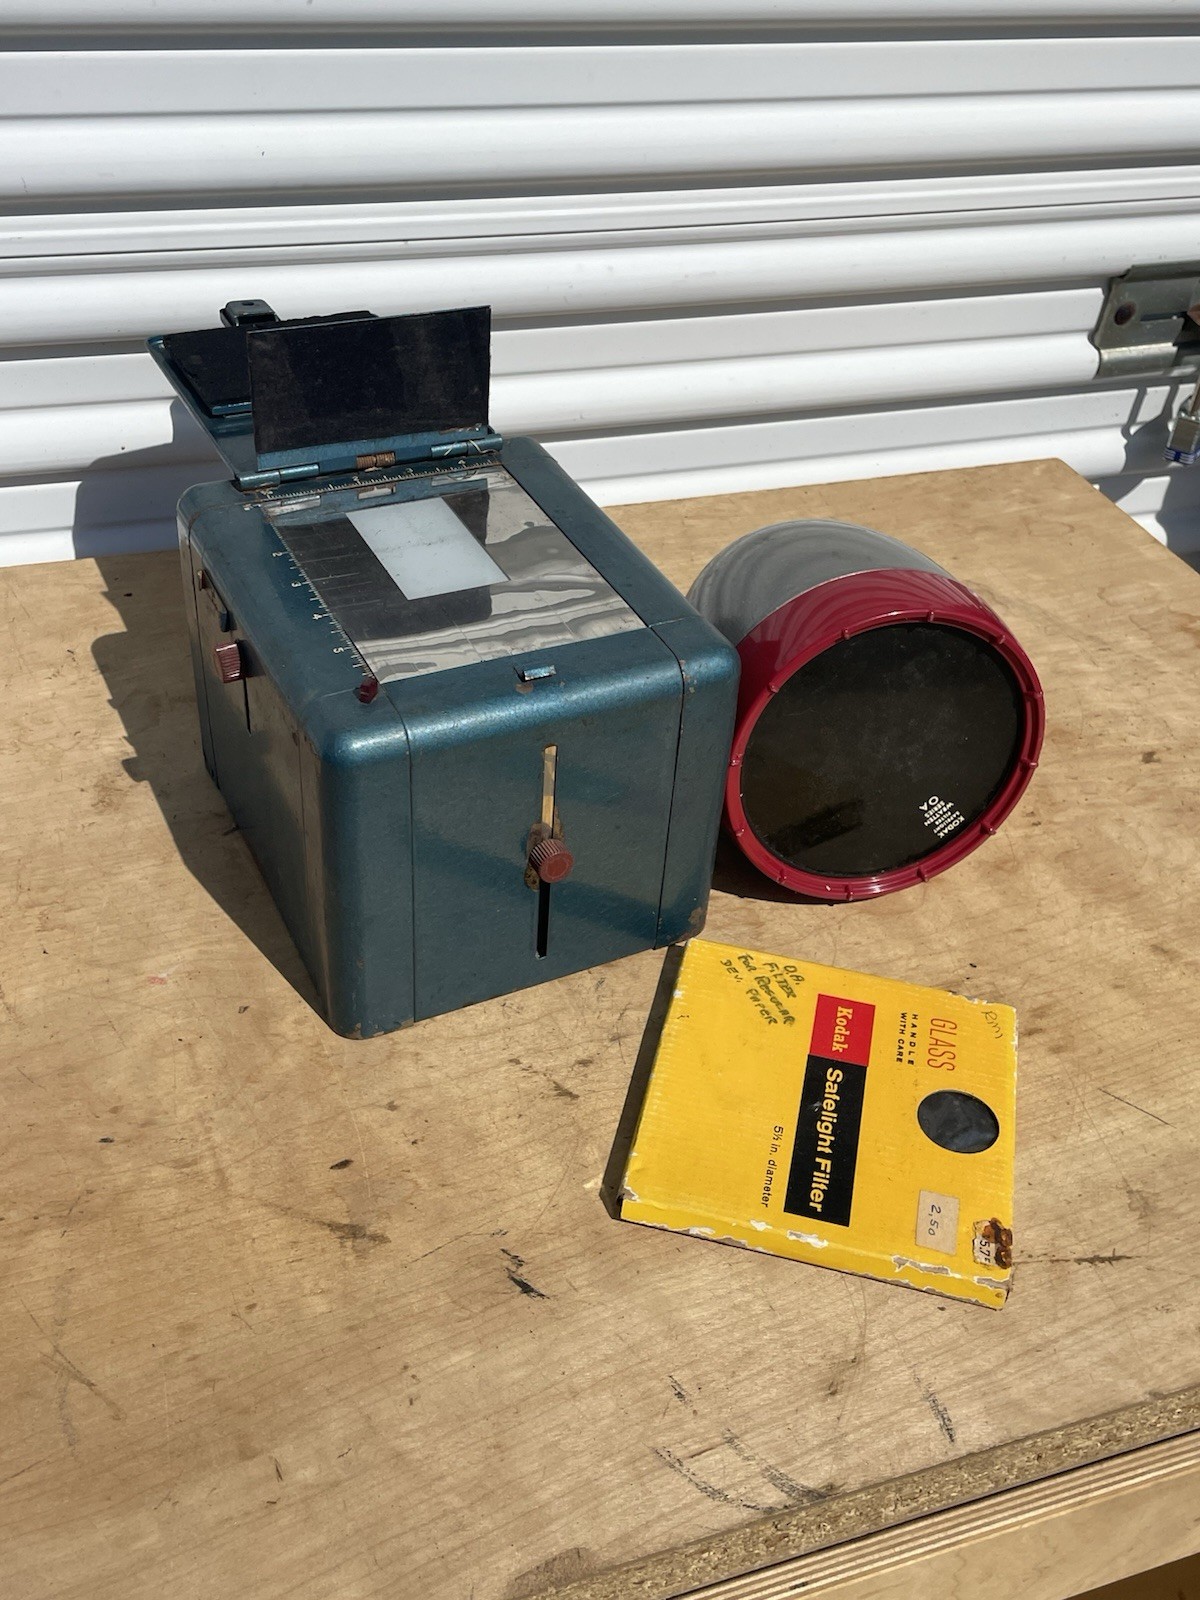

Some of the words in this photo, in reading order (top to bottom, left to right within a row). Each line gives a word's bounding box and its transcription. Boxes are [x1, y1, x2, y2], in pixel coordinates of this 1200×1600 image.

[312, 613, 323, 621] 4
[333, 647, 345, 655] 5
[918, 795, 939, 812] OA
[923, 802, 954, 827] WRATTEN
[924, 800, 945, 818] SERIES
[933, 810, 961, 834] SAFELIGHT
[934, 811, 952, 825] FILTER
[936, 815, 965, 839] KODAK
[831, 1005, 854, 1053] Kodak
[899, 1012, 908, 1036] WITH
[896, 1038, 905, 1063] CARE
[907, 1013, 919, 1066] HANDLE
[926, 1018, 958, 1072] GLASS
[816, 1067, 844, 1155] Safelight
[769, 1144, 781, 1157] in.
[760, 1158, 778, 1209] diameter
[808, 1156, 833, 1213] Filter
